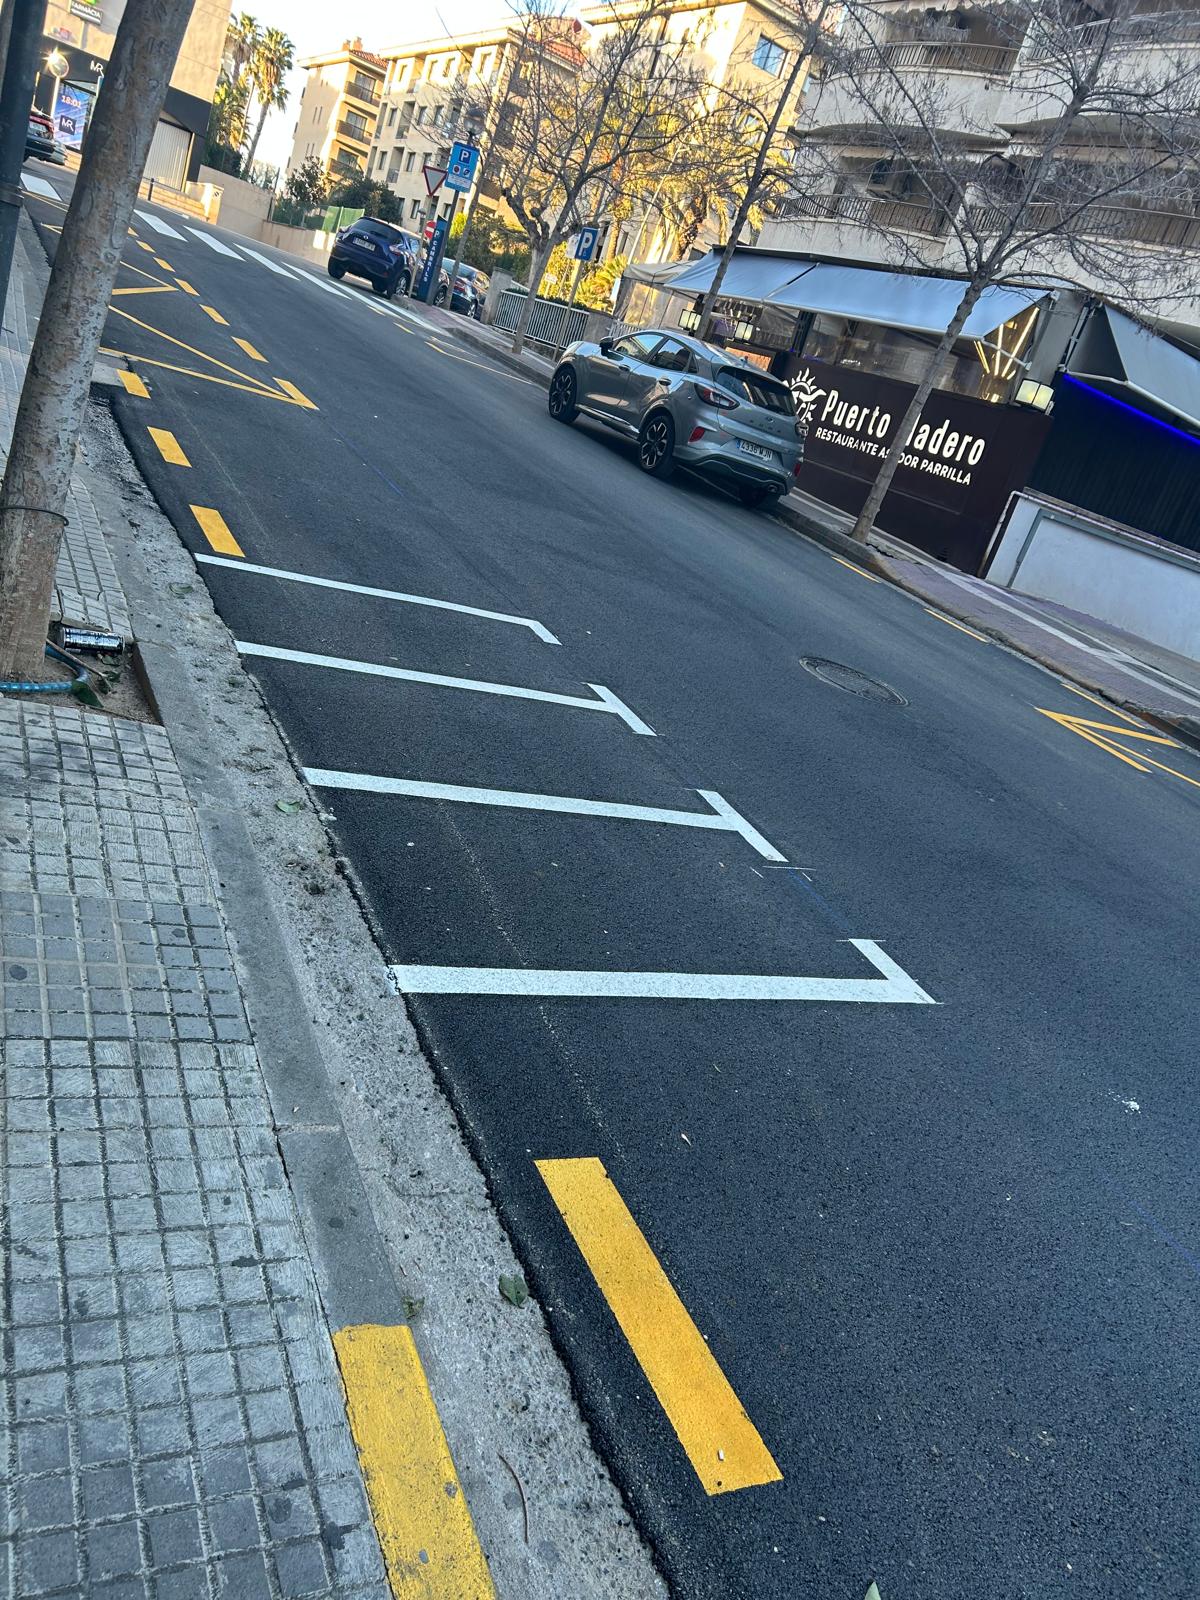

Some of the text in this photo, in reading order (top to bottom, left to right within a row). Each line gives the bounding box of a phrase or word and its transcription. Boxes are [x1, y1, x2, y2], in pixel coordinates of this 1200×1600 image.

[460, 150, 469, 161] P
[423, 240, 438, 282] CAMBRILS
[578, 231, 593, 256] P
[821, 390, 891, 438] Puerto
[815, 426, 879, 456] RESTAURANTE
[919, 459, 972, 486] PARRILLA
